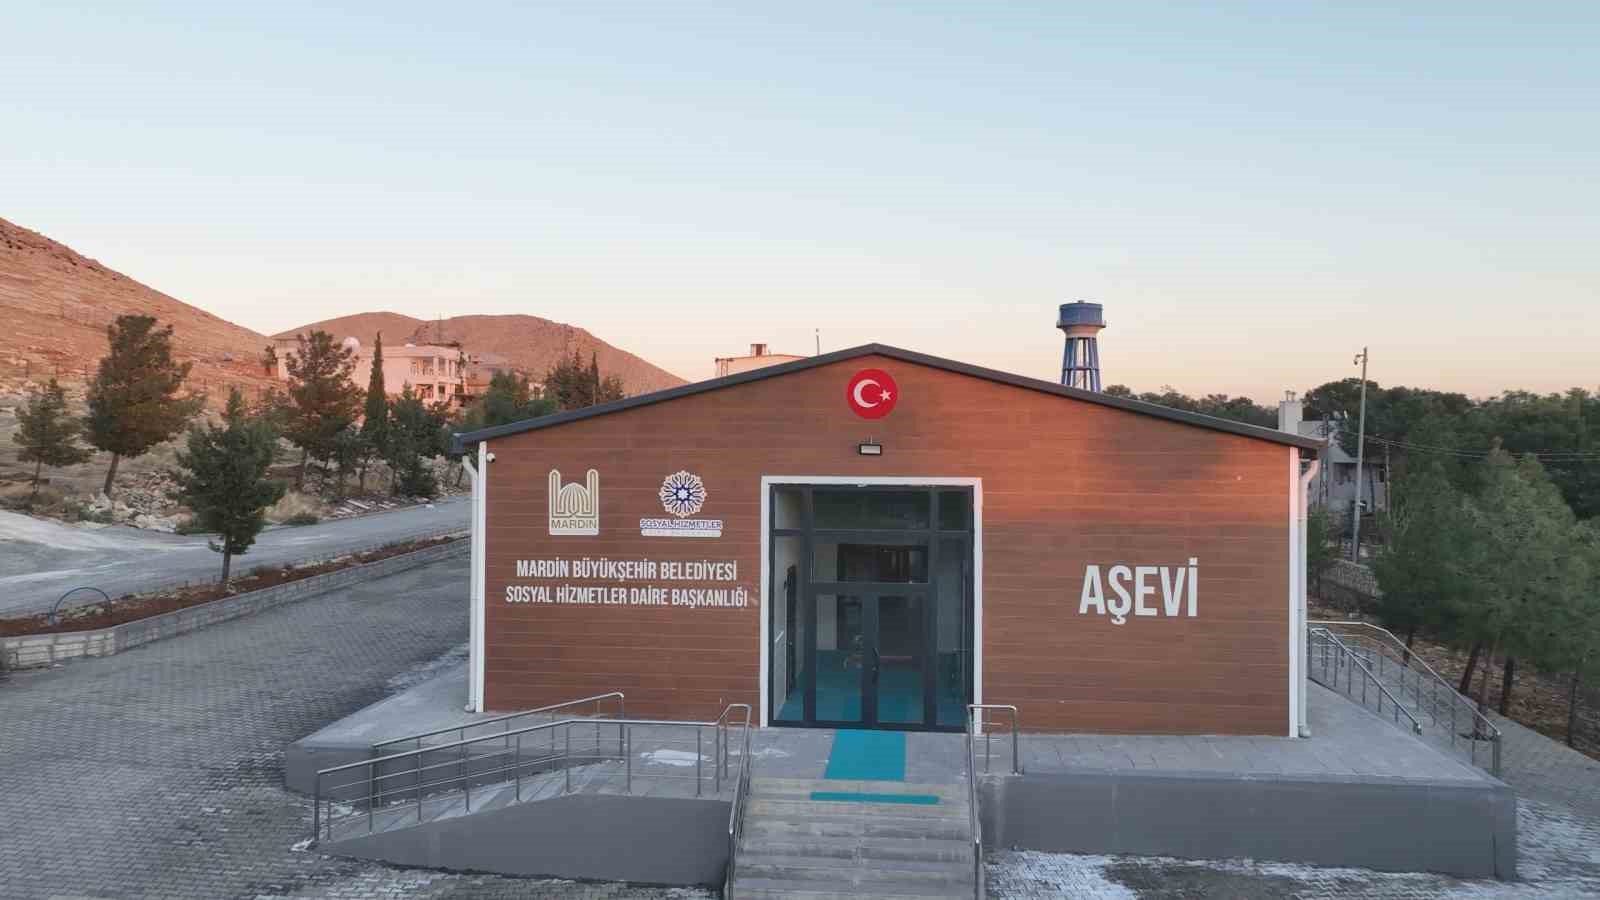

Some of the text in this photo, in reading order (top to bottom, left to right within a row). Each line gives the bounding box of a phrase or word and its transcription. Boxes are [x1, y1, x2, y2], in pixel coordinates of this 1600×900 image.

[640, 519, 673, 529] SOSYAL
[516, 557, 737, 582] MARDİN BÜYÜKŞEHİR BELEDİYESİ
[506, 584, 748, 608] SOSYAL HİZMETLER DAİRE BAŞKANLIĞI
[1079, 557, 1198, 625] AŞEVİ
